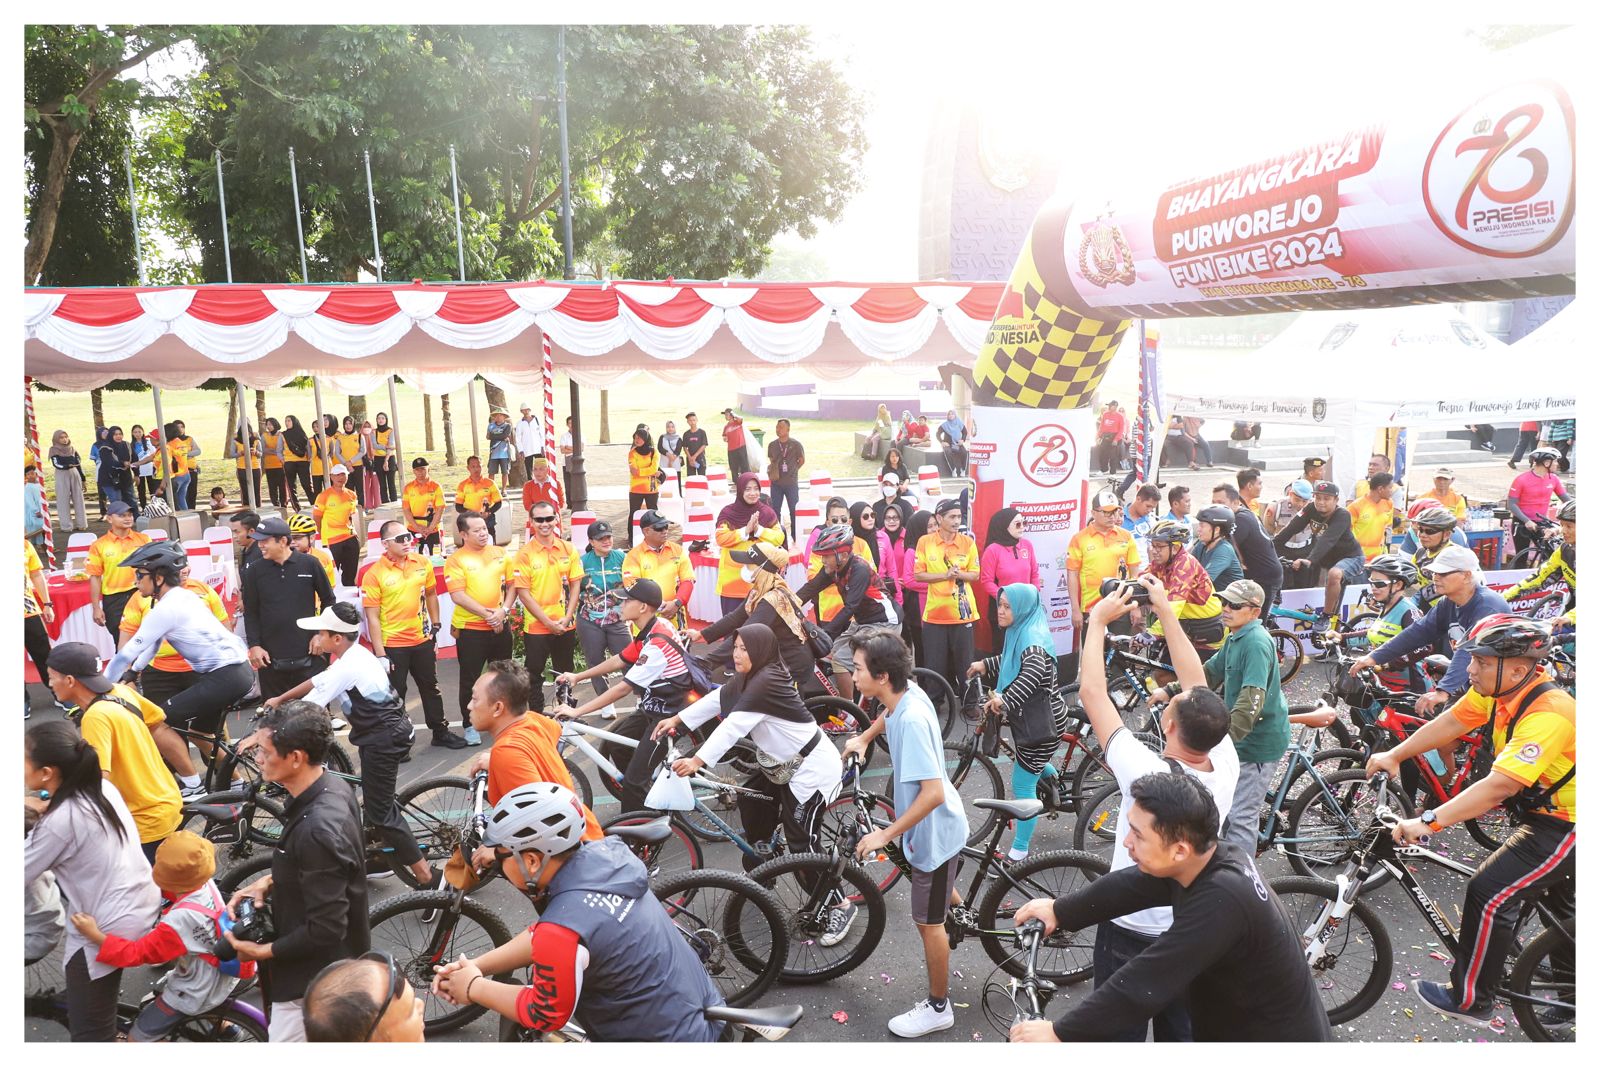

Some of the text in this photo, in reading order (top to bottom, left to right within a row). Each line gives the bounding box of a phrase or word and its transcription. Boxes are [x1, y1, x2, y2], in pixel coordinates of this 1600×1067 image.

[1166, 138, 1361, 220] BHAYANGKARA
[1171, 194, 1322, 256] PURWOREJO
[1473, 200, 1555, 226] PRESISI
[1501, 220, 1536, 230] INDONESIA
[1537, 217, 1556, 225] EMAS
[1170, 231, 1343, 287] FUN BIKE 2024
[1229, 280, 1313, 297] BHAYANGKARA
[1313, 277, 1335, 290] KE
[1345, 275, 1367, 287] 78
[1469, 399, 1513, 415] Purworejo
[1023, 513, 1067, 523] URWOREJO
[1031, 523, 1050, 532] BIKE
[1051, 521, 1070, 530] 2024
[815, 670, 838, 697] POLYGO
[1411, 886, 1450, 937] POLYGON
